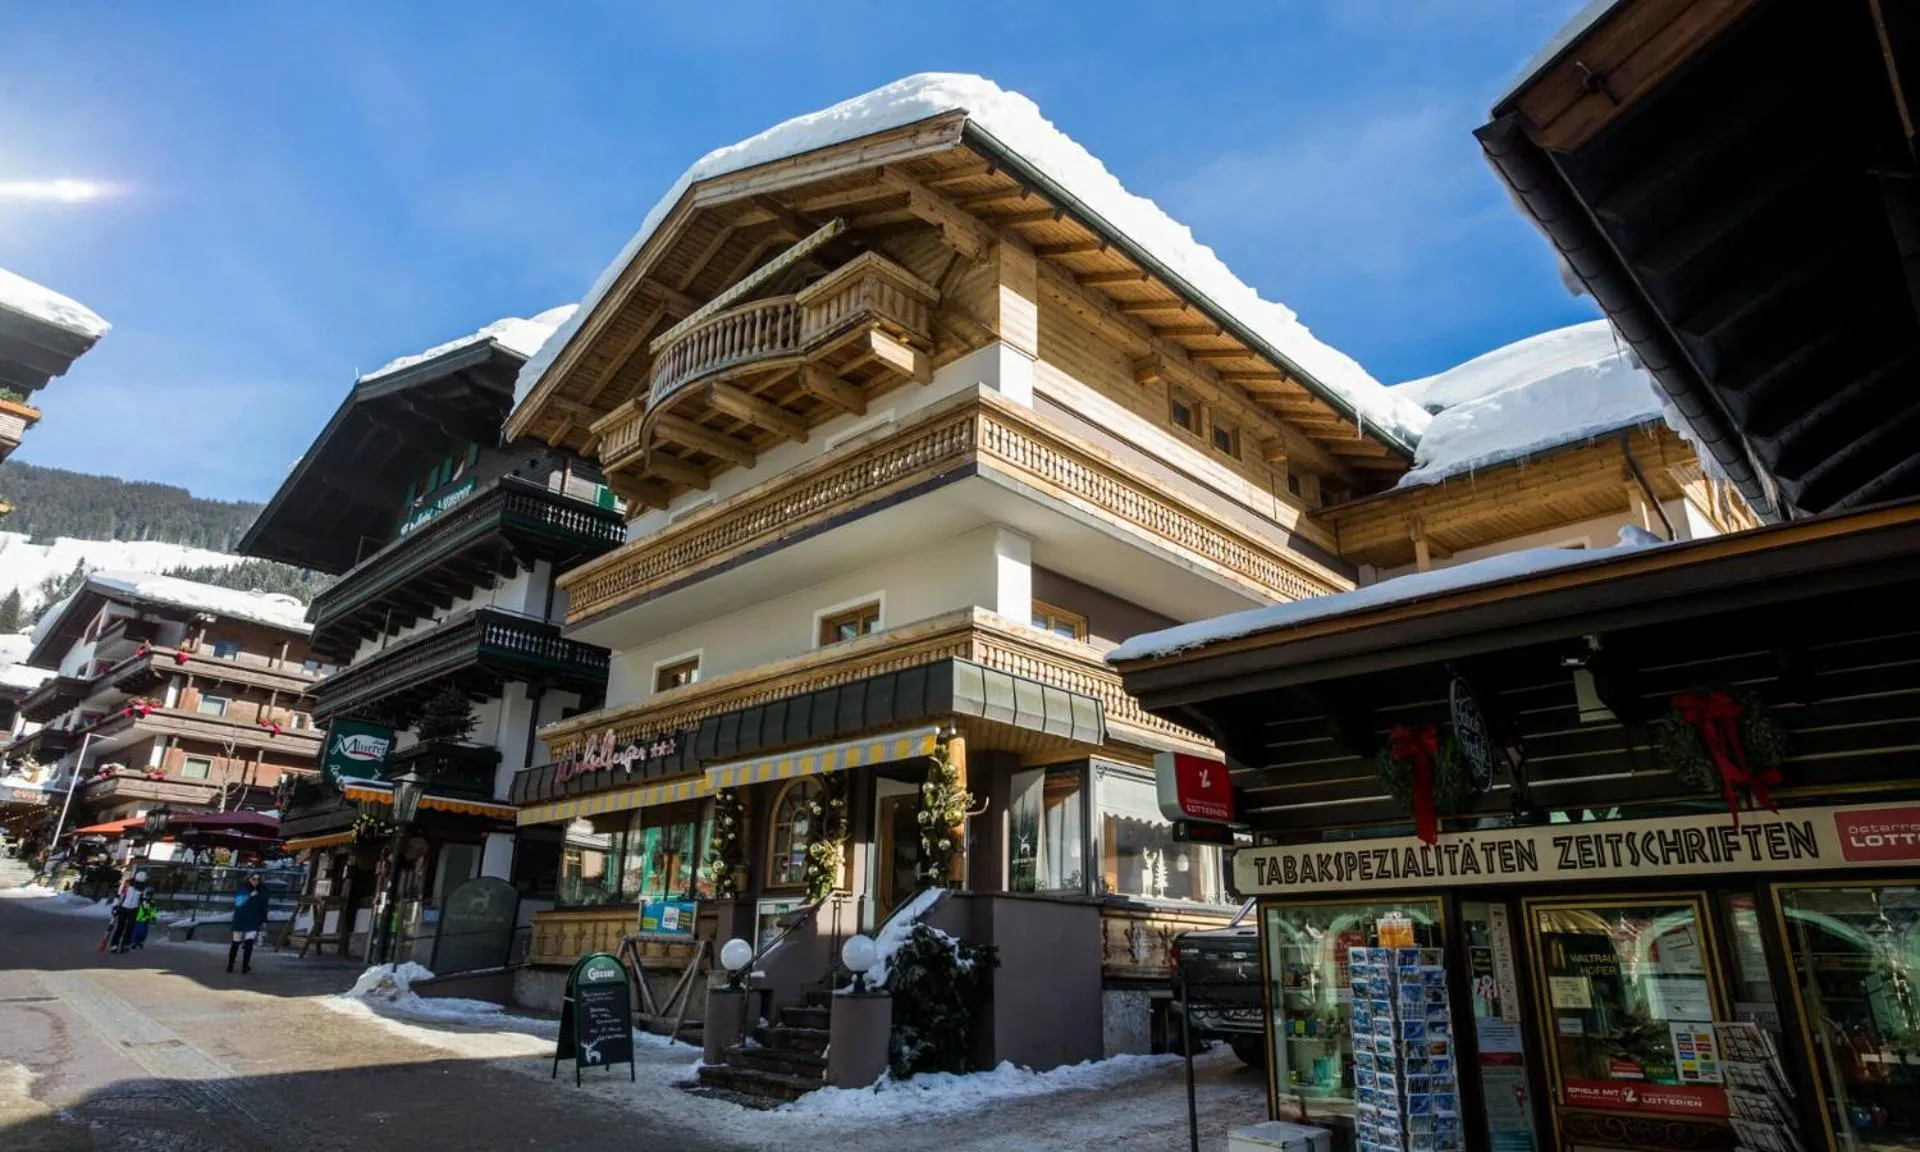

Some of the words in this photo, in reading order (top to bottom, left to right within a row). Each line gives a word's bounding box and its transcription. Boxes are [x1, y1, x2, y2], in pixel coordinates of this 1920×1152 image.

[1850, 833, 1920, 847] LOTT
[1253, 837, 1539, 886] TABAKSPEZIALITÄTEN
[1553, 820, 1820, 870] ZEITSCHRIFTEN
[1567, 1086, 1600, 1095] SPIELE
[1602, 1088, 1621, 1097] MIT
[1642, 1097, 1703, 1108] LOTTERIEN
